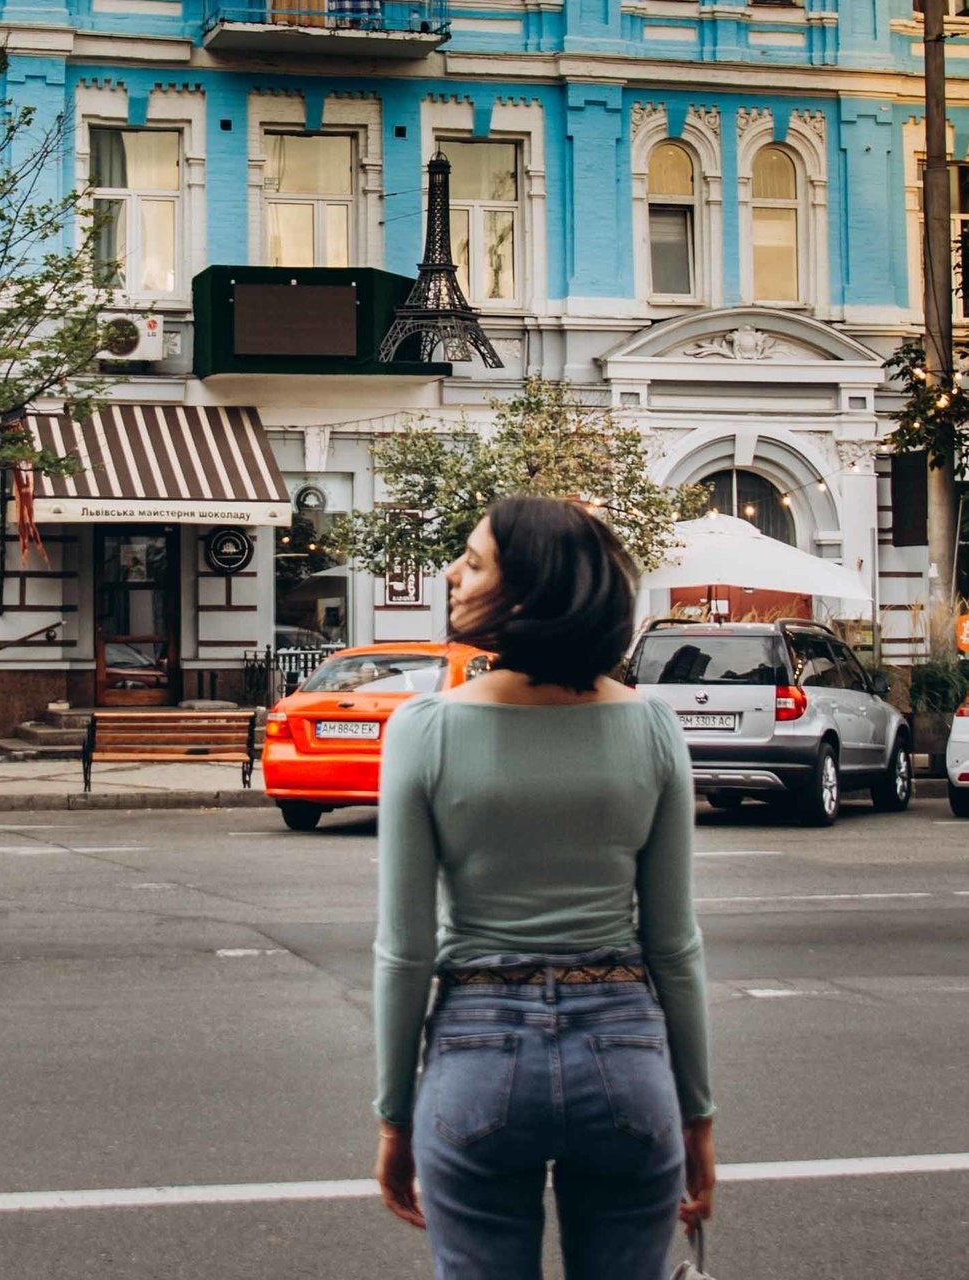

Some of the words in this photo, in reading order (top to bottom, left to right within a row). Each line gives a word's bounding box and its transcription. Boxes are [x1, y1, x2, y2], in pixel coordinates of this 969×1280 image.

[81, 507, 135, 518] Львівська
[138, 507, 196, 519] майстерня
[199, 510, 251, 521] шоколаду
[718, 716, 732, 726] AC
[322, 723, 336, 734] AM
[338, 723, 360, 734] 8842
[362, 723, 376, 735] EK
